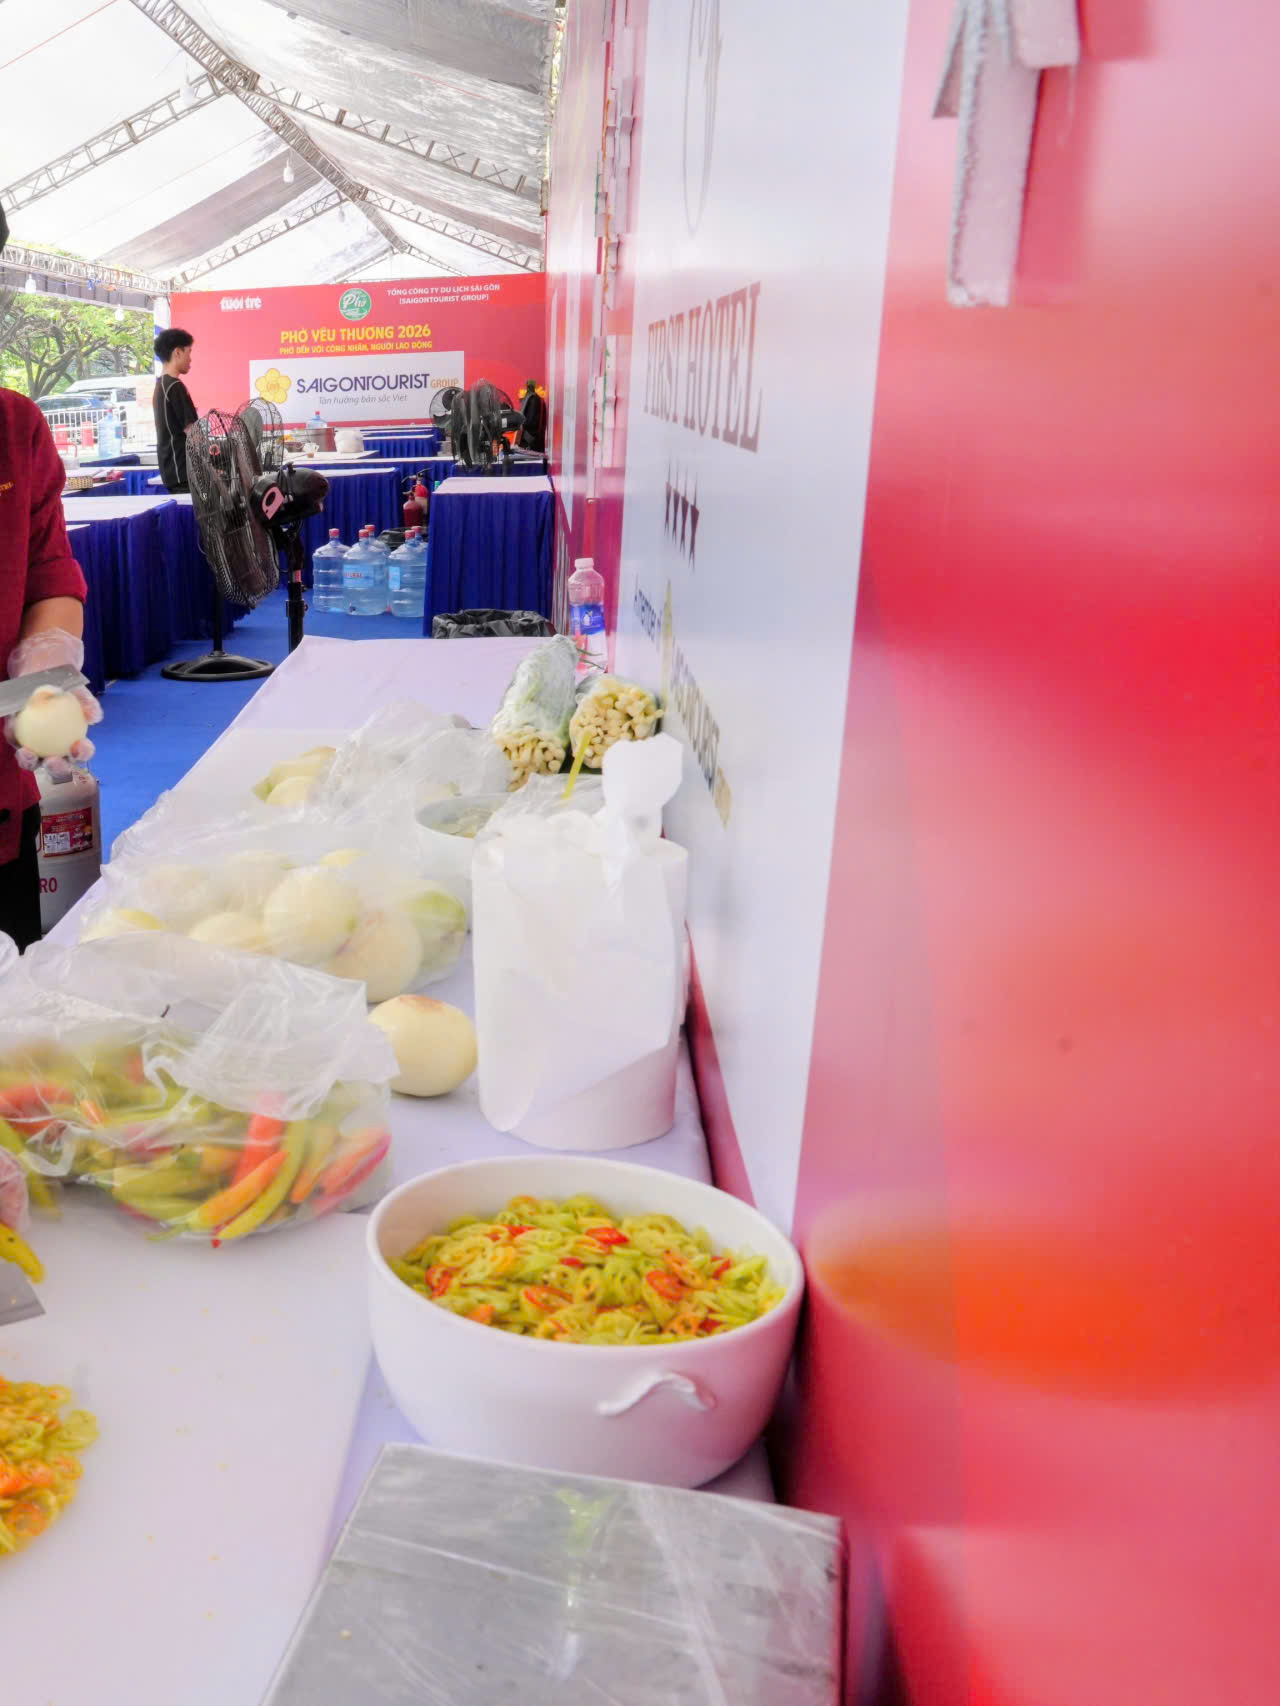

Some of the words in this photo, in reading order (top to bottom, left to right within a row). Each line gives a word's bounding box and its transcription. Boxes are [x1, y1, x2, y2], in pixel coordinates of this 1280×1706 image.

[408, 287, 429, 295] CÔNG
[312, 326, 336, 342] YÊU
[398, 324, 431, 338] 2026
[644, 312, 684, 423] FIRST
[683, 280, 762, 453] HOTEL
[296, 374, 430, 393] SAIGONTOURIST
[431, 378, 459, 388] GROUP
[39, 877, 58, 894] RO
